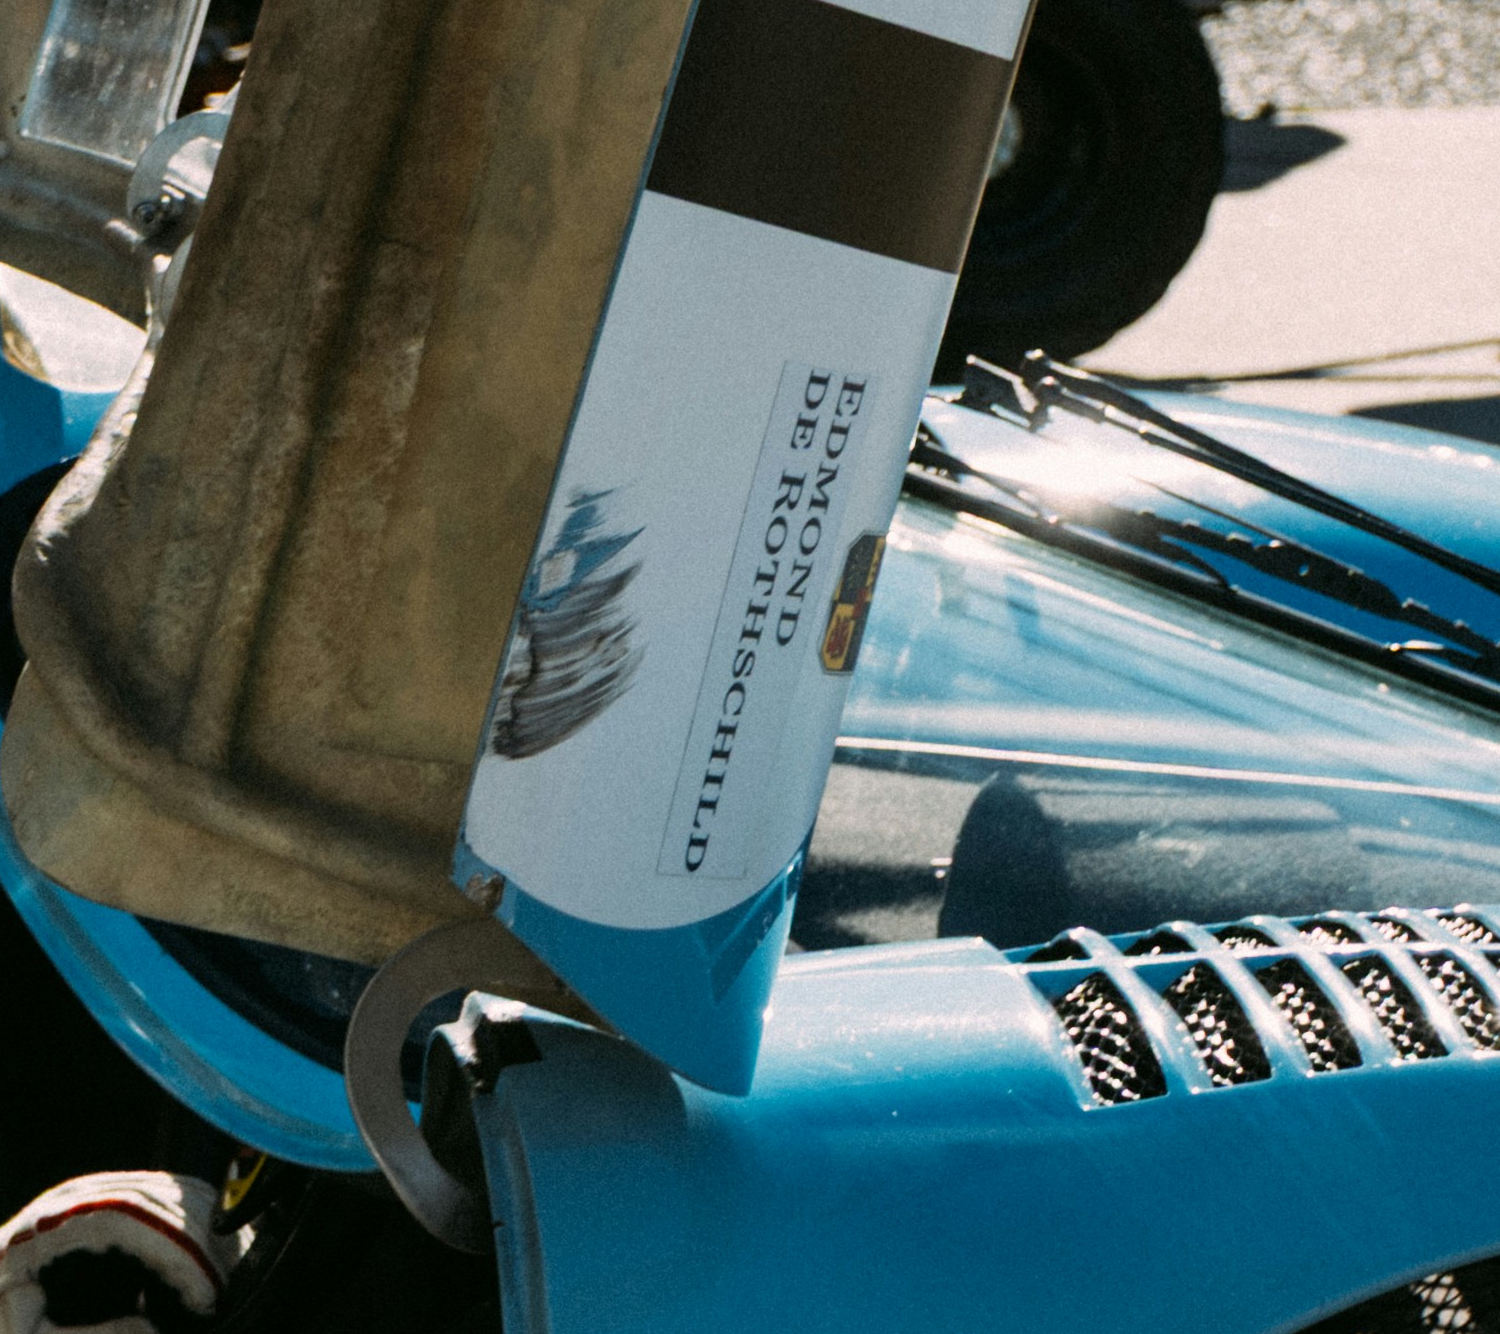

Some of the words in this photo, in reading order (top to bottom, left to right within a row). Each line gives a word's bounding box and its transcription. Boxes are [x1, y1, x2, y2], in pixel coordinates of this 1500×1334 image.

[776, 377, 868, 648] EDMOND
[790, 370, 832, 451] DE
[685, 469, 806, 873] ROTHSCHILD
